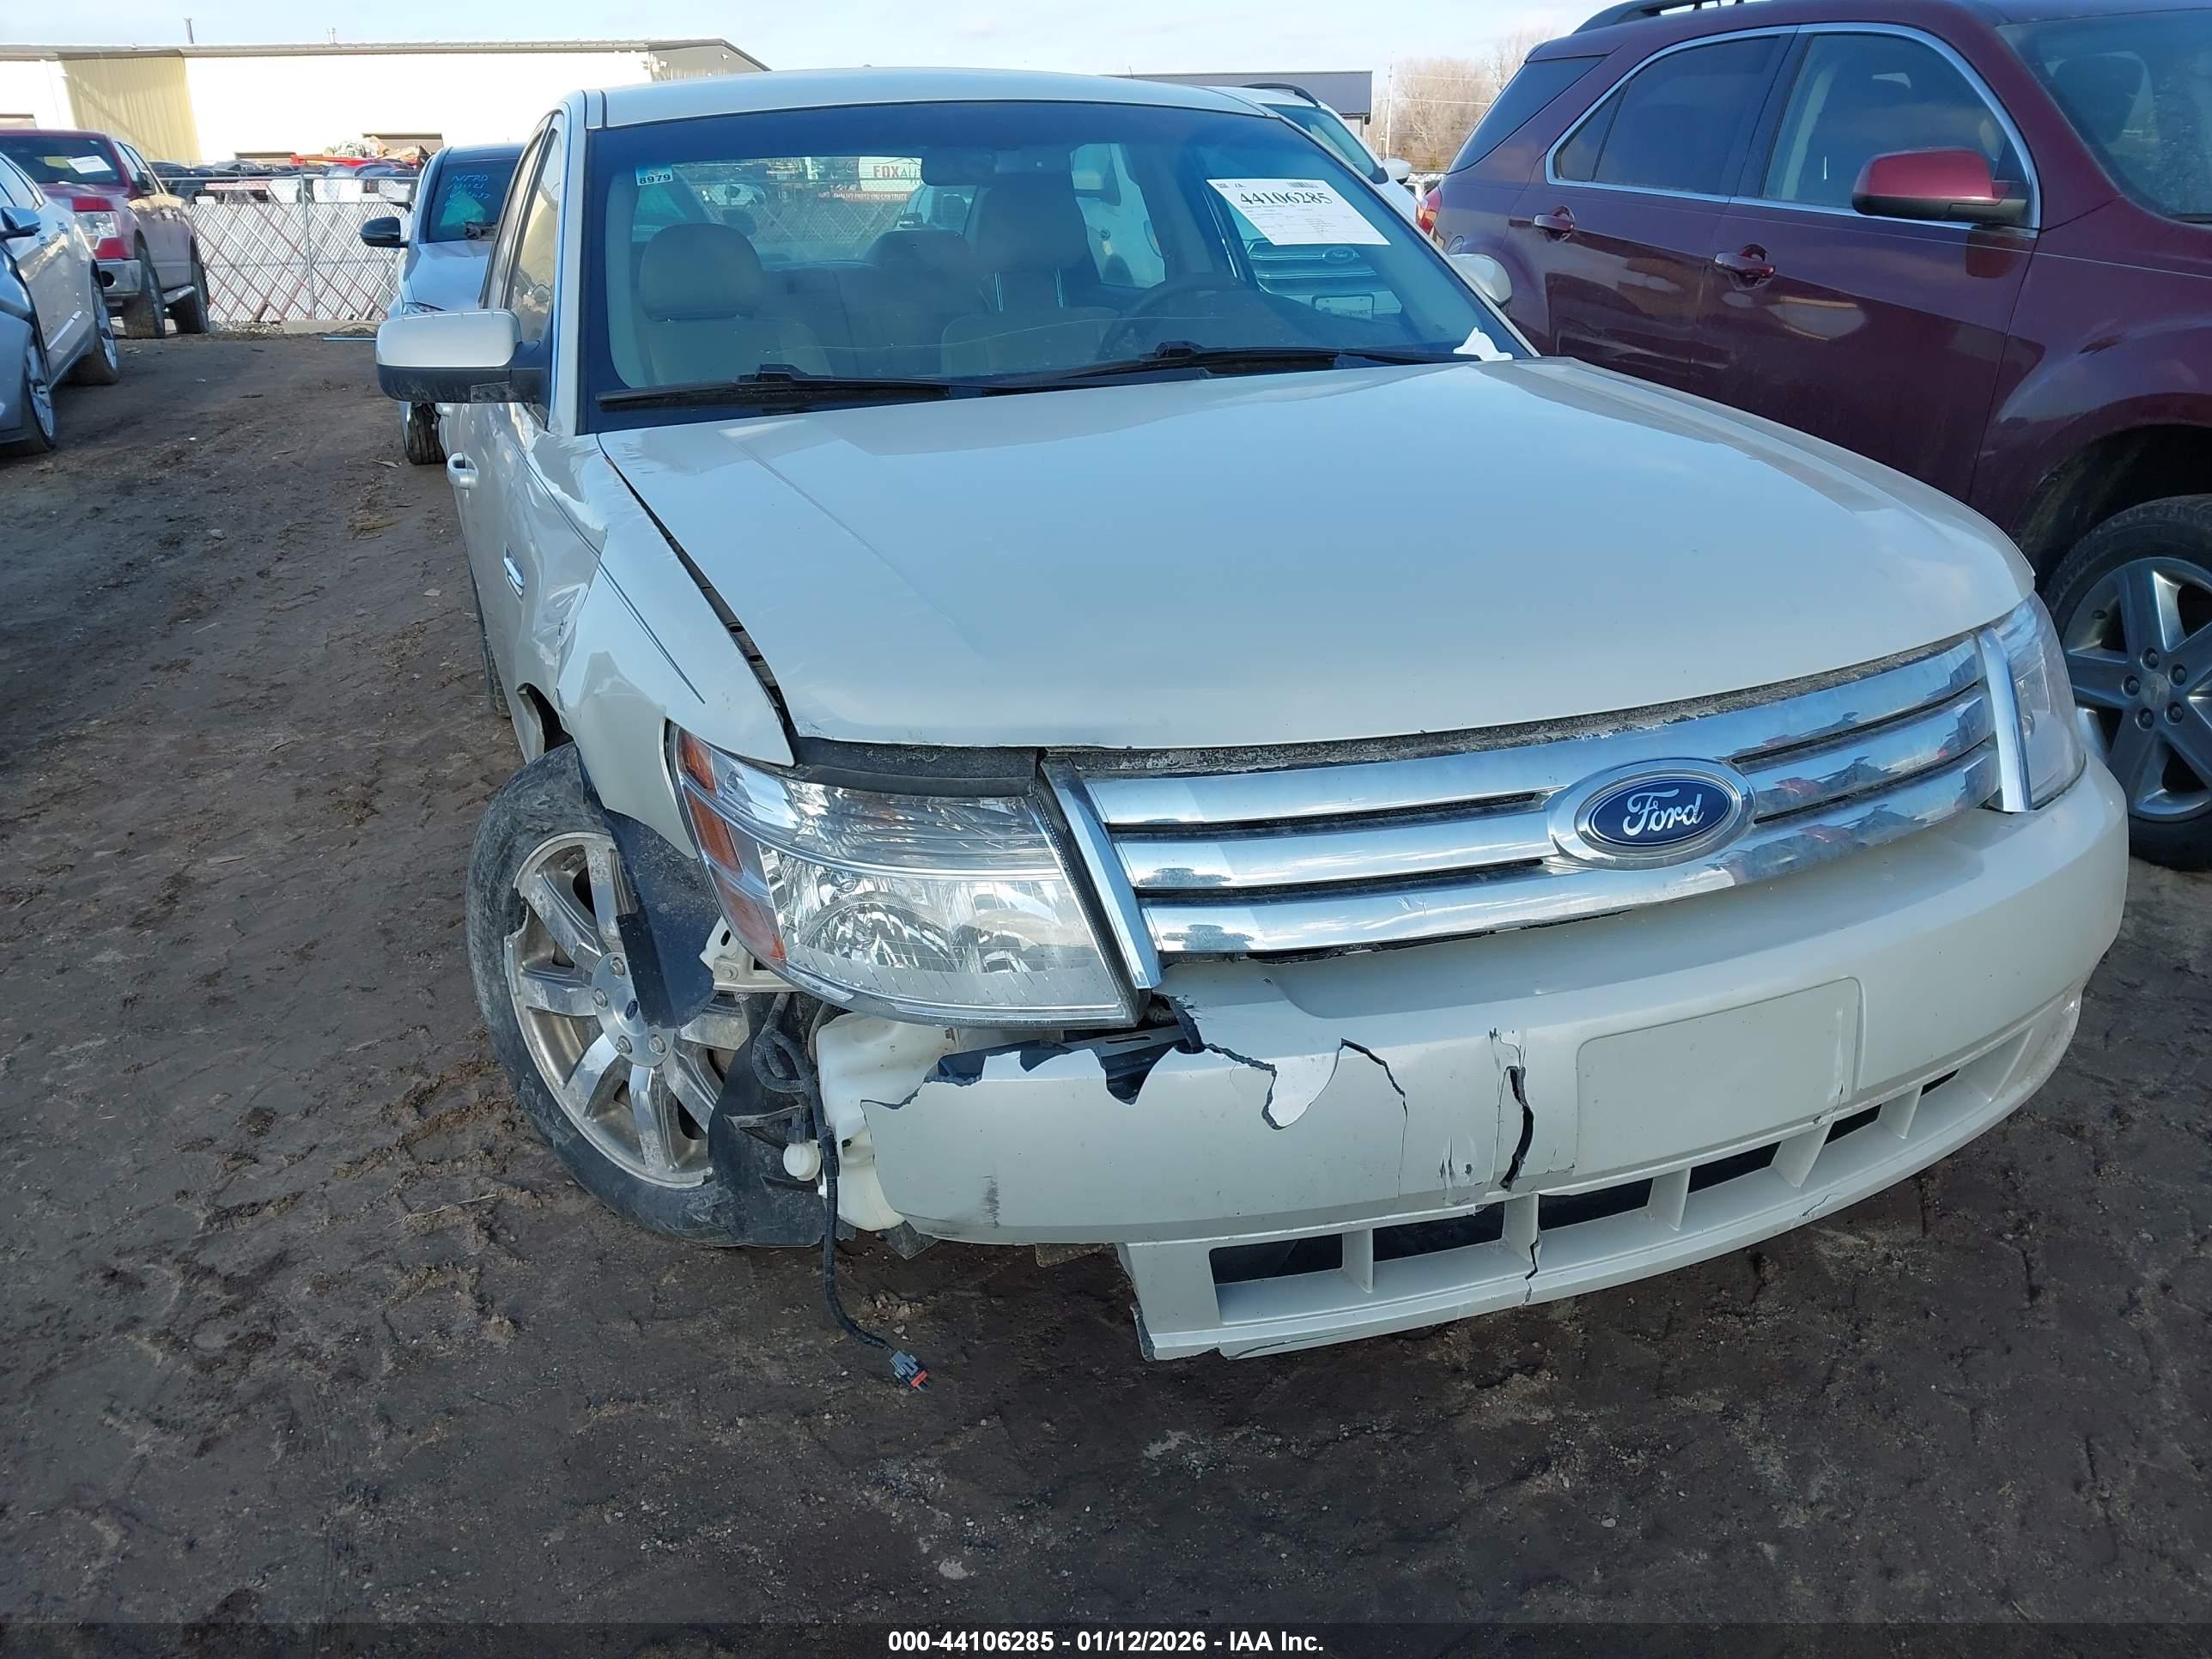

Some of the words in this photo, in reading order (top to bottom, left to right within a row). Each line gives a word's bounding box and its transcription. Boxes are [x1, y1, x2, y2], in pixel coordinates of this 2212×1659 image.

[872, 166, 899, 178] FOX
[639, 173, 671, 184] 8979
[1240, 191, 1333, 204] 44106285
[1622, 788, 1704, 836] Ford
